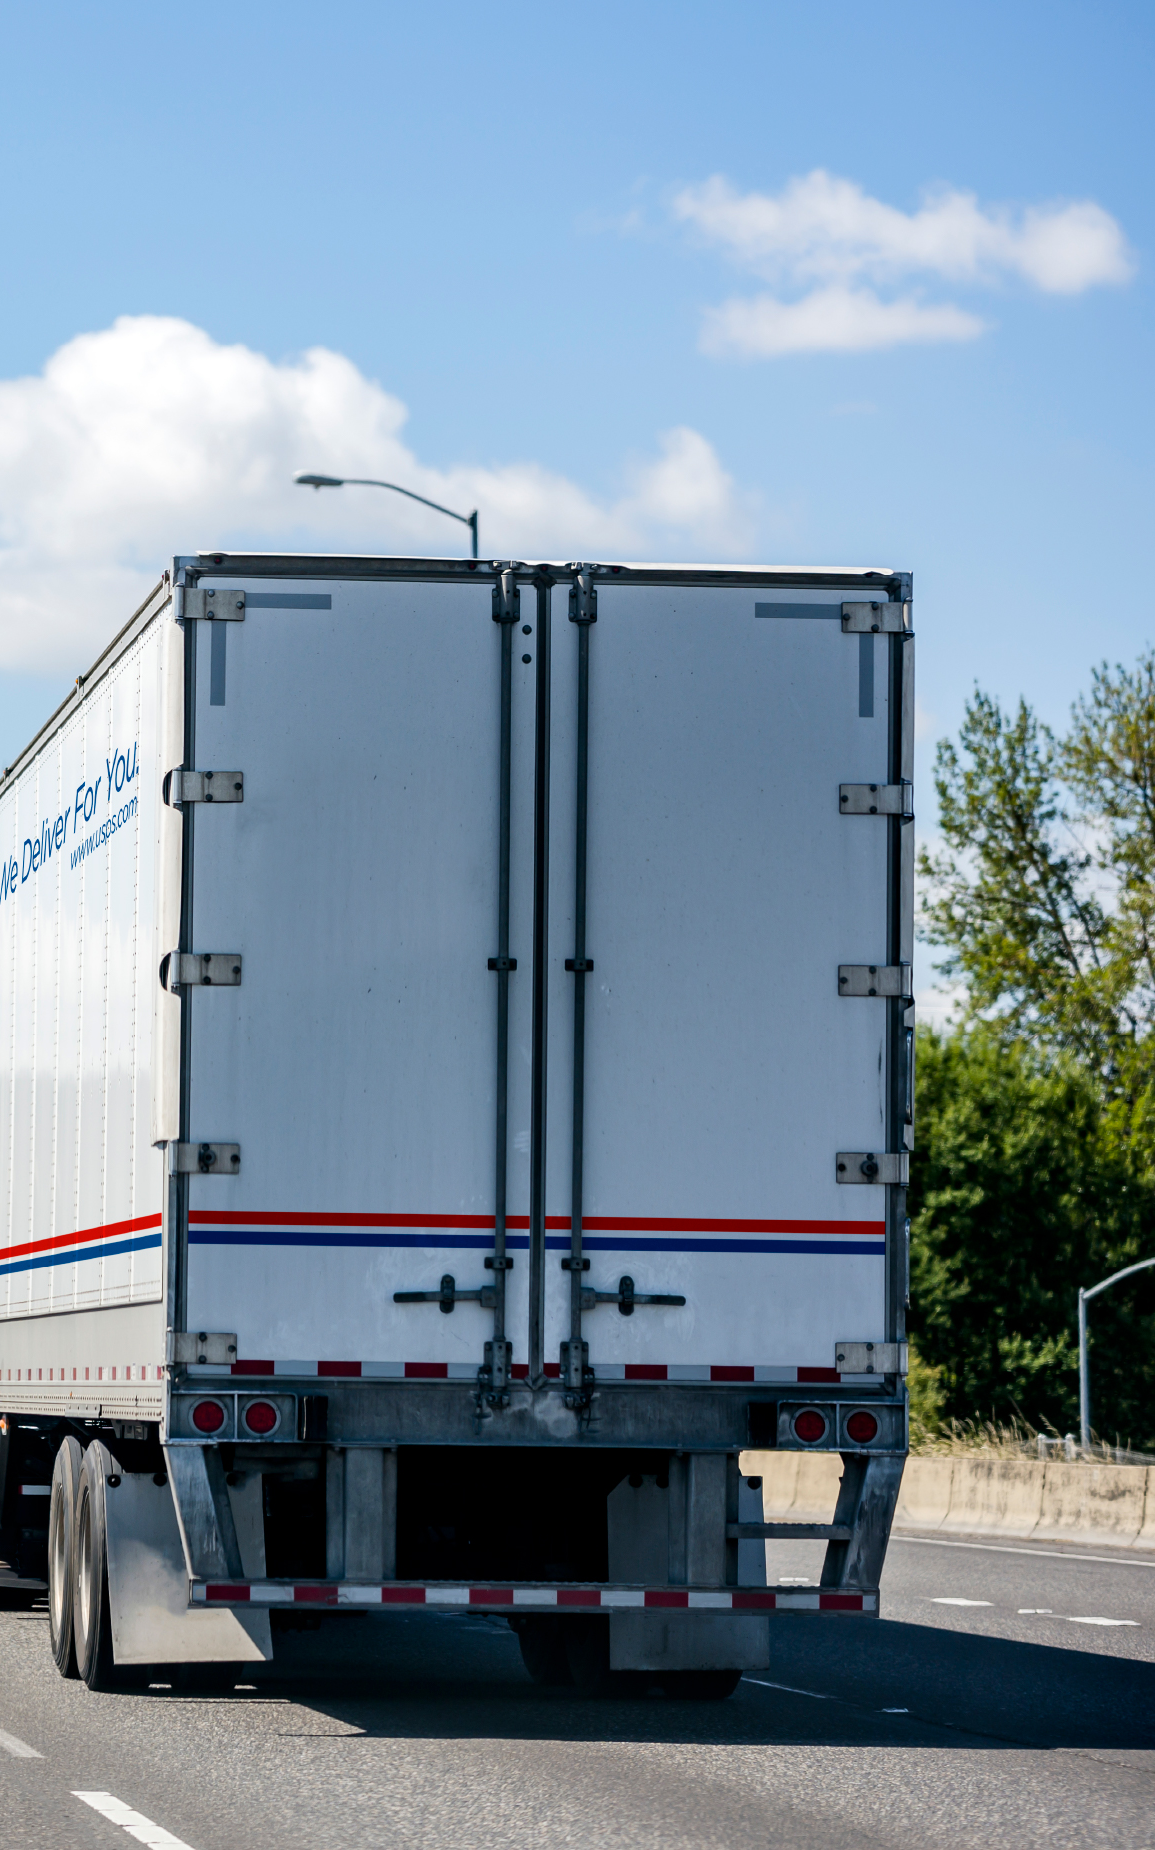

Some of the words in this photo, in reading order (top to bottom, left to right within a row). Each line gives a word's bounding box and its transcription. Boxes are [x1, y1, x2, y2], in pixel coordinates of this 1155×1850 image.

[21, 806, 71, 884] Deliver
[73, 776, 102, 834] For
[106, 741, 140, 802] You.
[70, 796, 138, 871] www.usps.com
